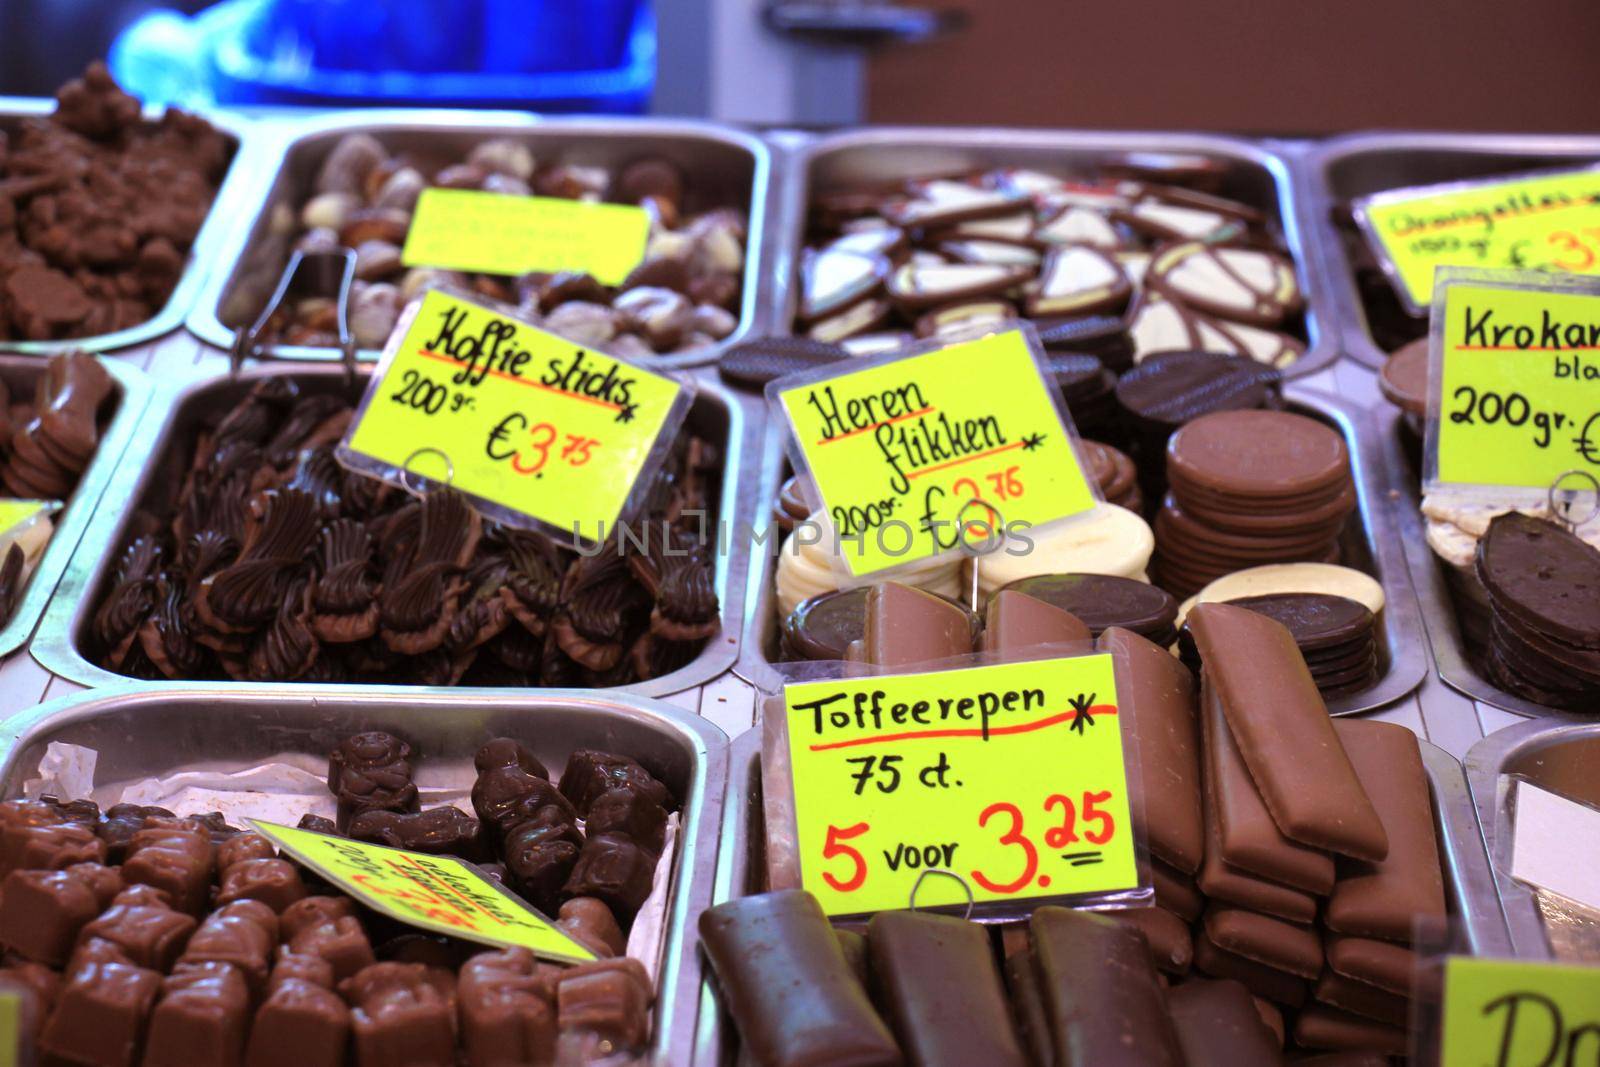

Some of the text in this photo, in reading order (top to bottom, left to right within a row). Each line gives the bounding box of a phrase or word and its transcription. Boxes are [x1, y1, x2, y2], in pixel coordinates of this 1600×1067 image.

[426, 307, 531, 386] Koffie
[808, 382, 929, 442] Heren
[792, 688, 1045, 741] Toffeerepen
[845, 752, 963, 796] 75 ct.
[822, 822, 870, 892] 5
[883, 842, 959, 872] voor
